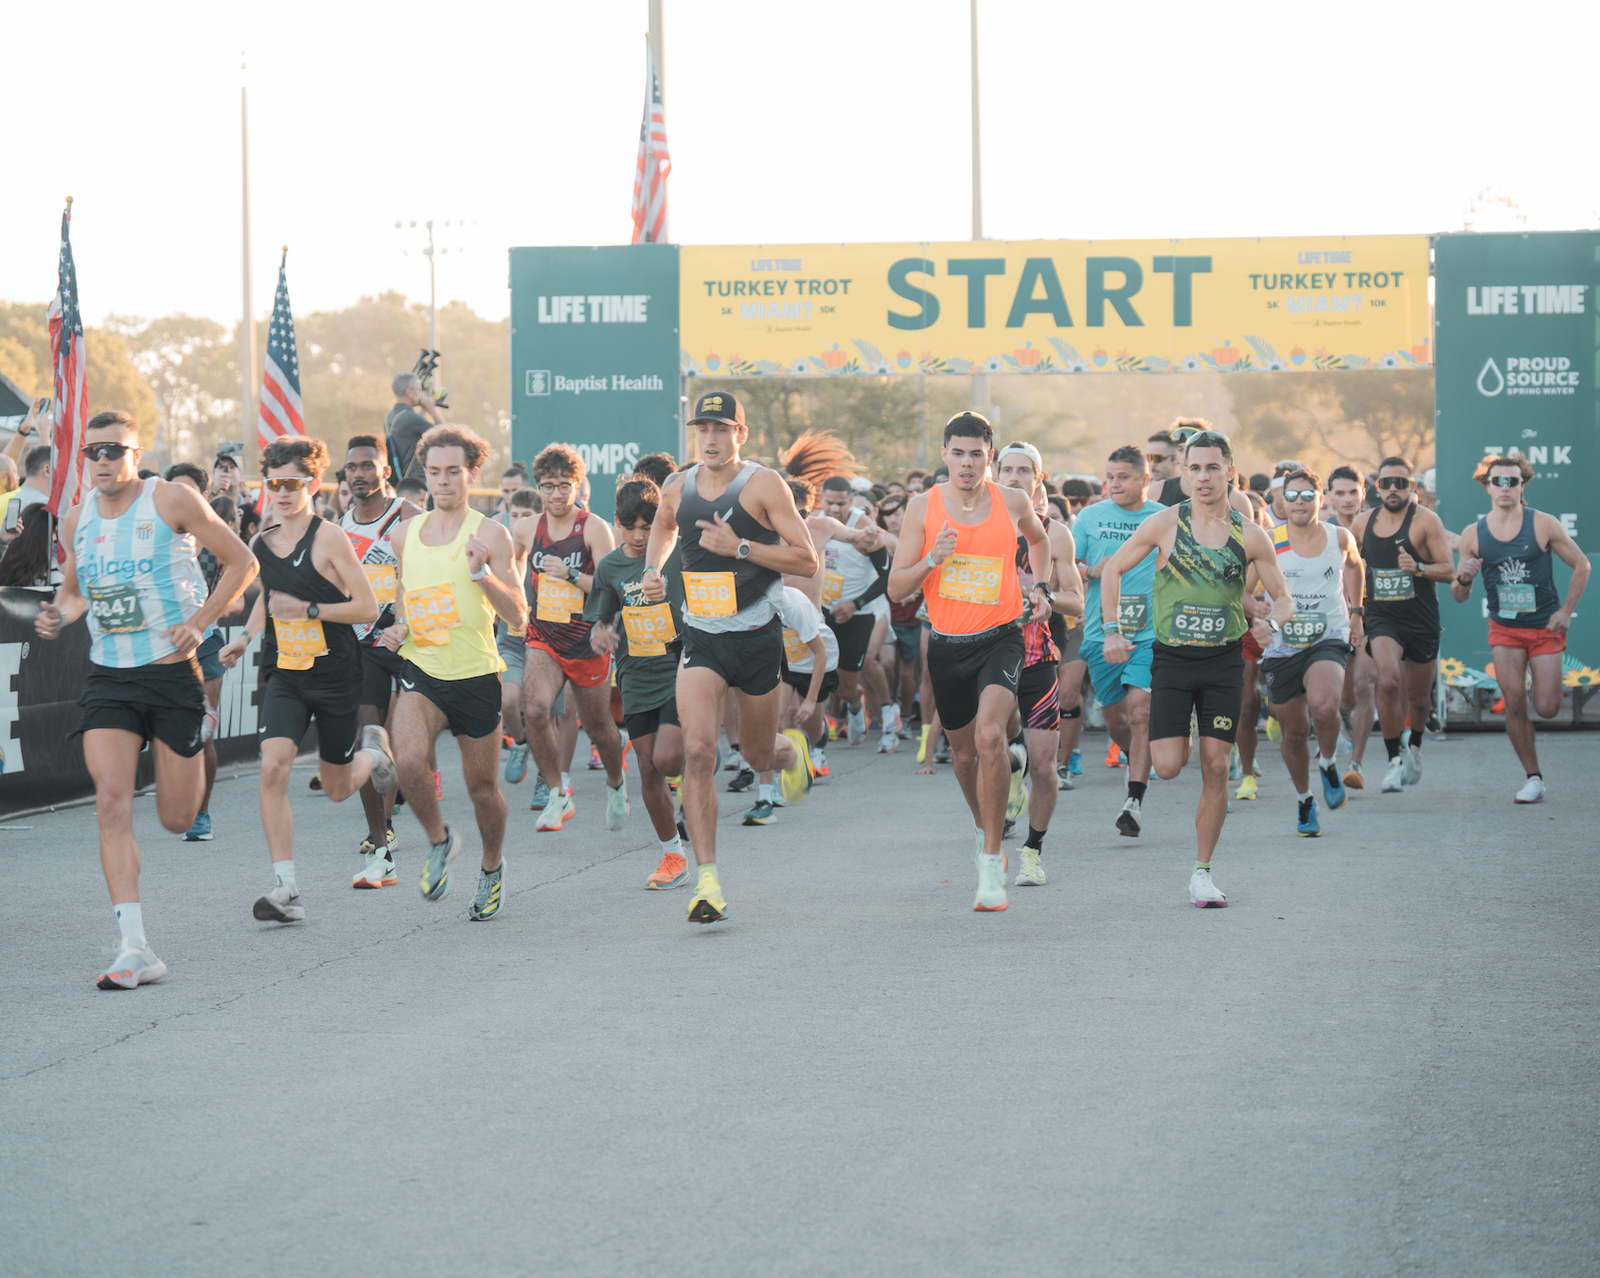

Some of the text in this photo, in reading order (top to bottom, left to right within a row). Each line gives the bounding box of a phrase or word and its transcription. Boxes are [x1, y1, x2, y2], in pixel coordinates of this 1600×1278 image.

[751, 258, 803, 272] LIFE TIME
[1298, 251, 1352, 264] LIFE TIME
[703, 279, 853, 297] TURKEY TROT
[1248, 271, 1405, 290] TURKEY TROT
[887, 256, 1213, 331] START
[1467, 284, 1586, 315] LIFE TIME
[538, 295, 648, 324] LIFE TIME
[721, 307, 733, 315] 5K
[819, 306, 836, 314] 10K
[1266, 300, 1280, 309] 5K
[1369, 299, 1388, 307] 10K
[1507, 357, 1571, 371] PROUD
[554, 374, 664, 395] Baptist Health
[1507, 371, 1580, 387] SOURCE
[1507, 387, 1575, 396] SPRING WATER
[1521, 428, 1538, 439] The
[1099, 531, 1134, 541] ARM
[943, 566, 999, 588] 2829
[1375, 576, 1411, 590] 6875
[539, 584, 582, 600] 2044
[688, 585, 730, 601] 3618
[963, 587, 976, 595] 5K
[1499, 592, 1534, 603] 8065
[91, 596, 137, 618] 6847
[407, 596, 454, 620] 3642
[628, 616, 667, 632] 1162
[1175, 614, 1226, 632] 6289
[1283, 622, 1325, 636] 6688
[276, 626, 321, 642] 2346
